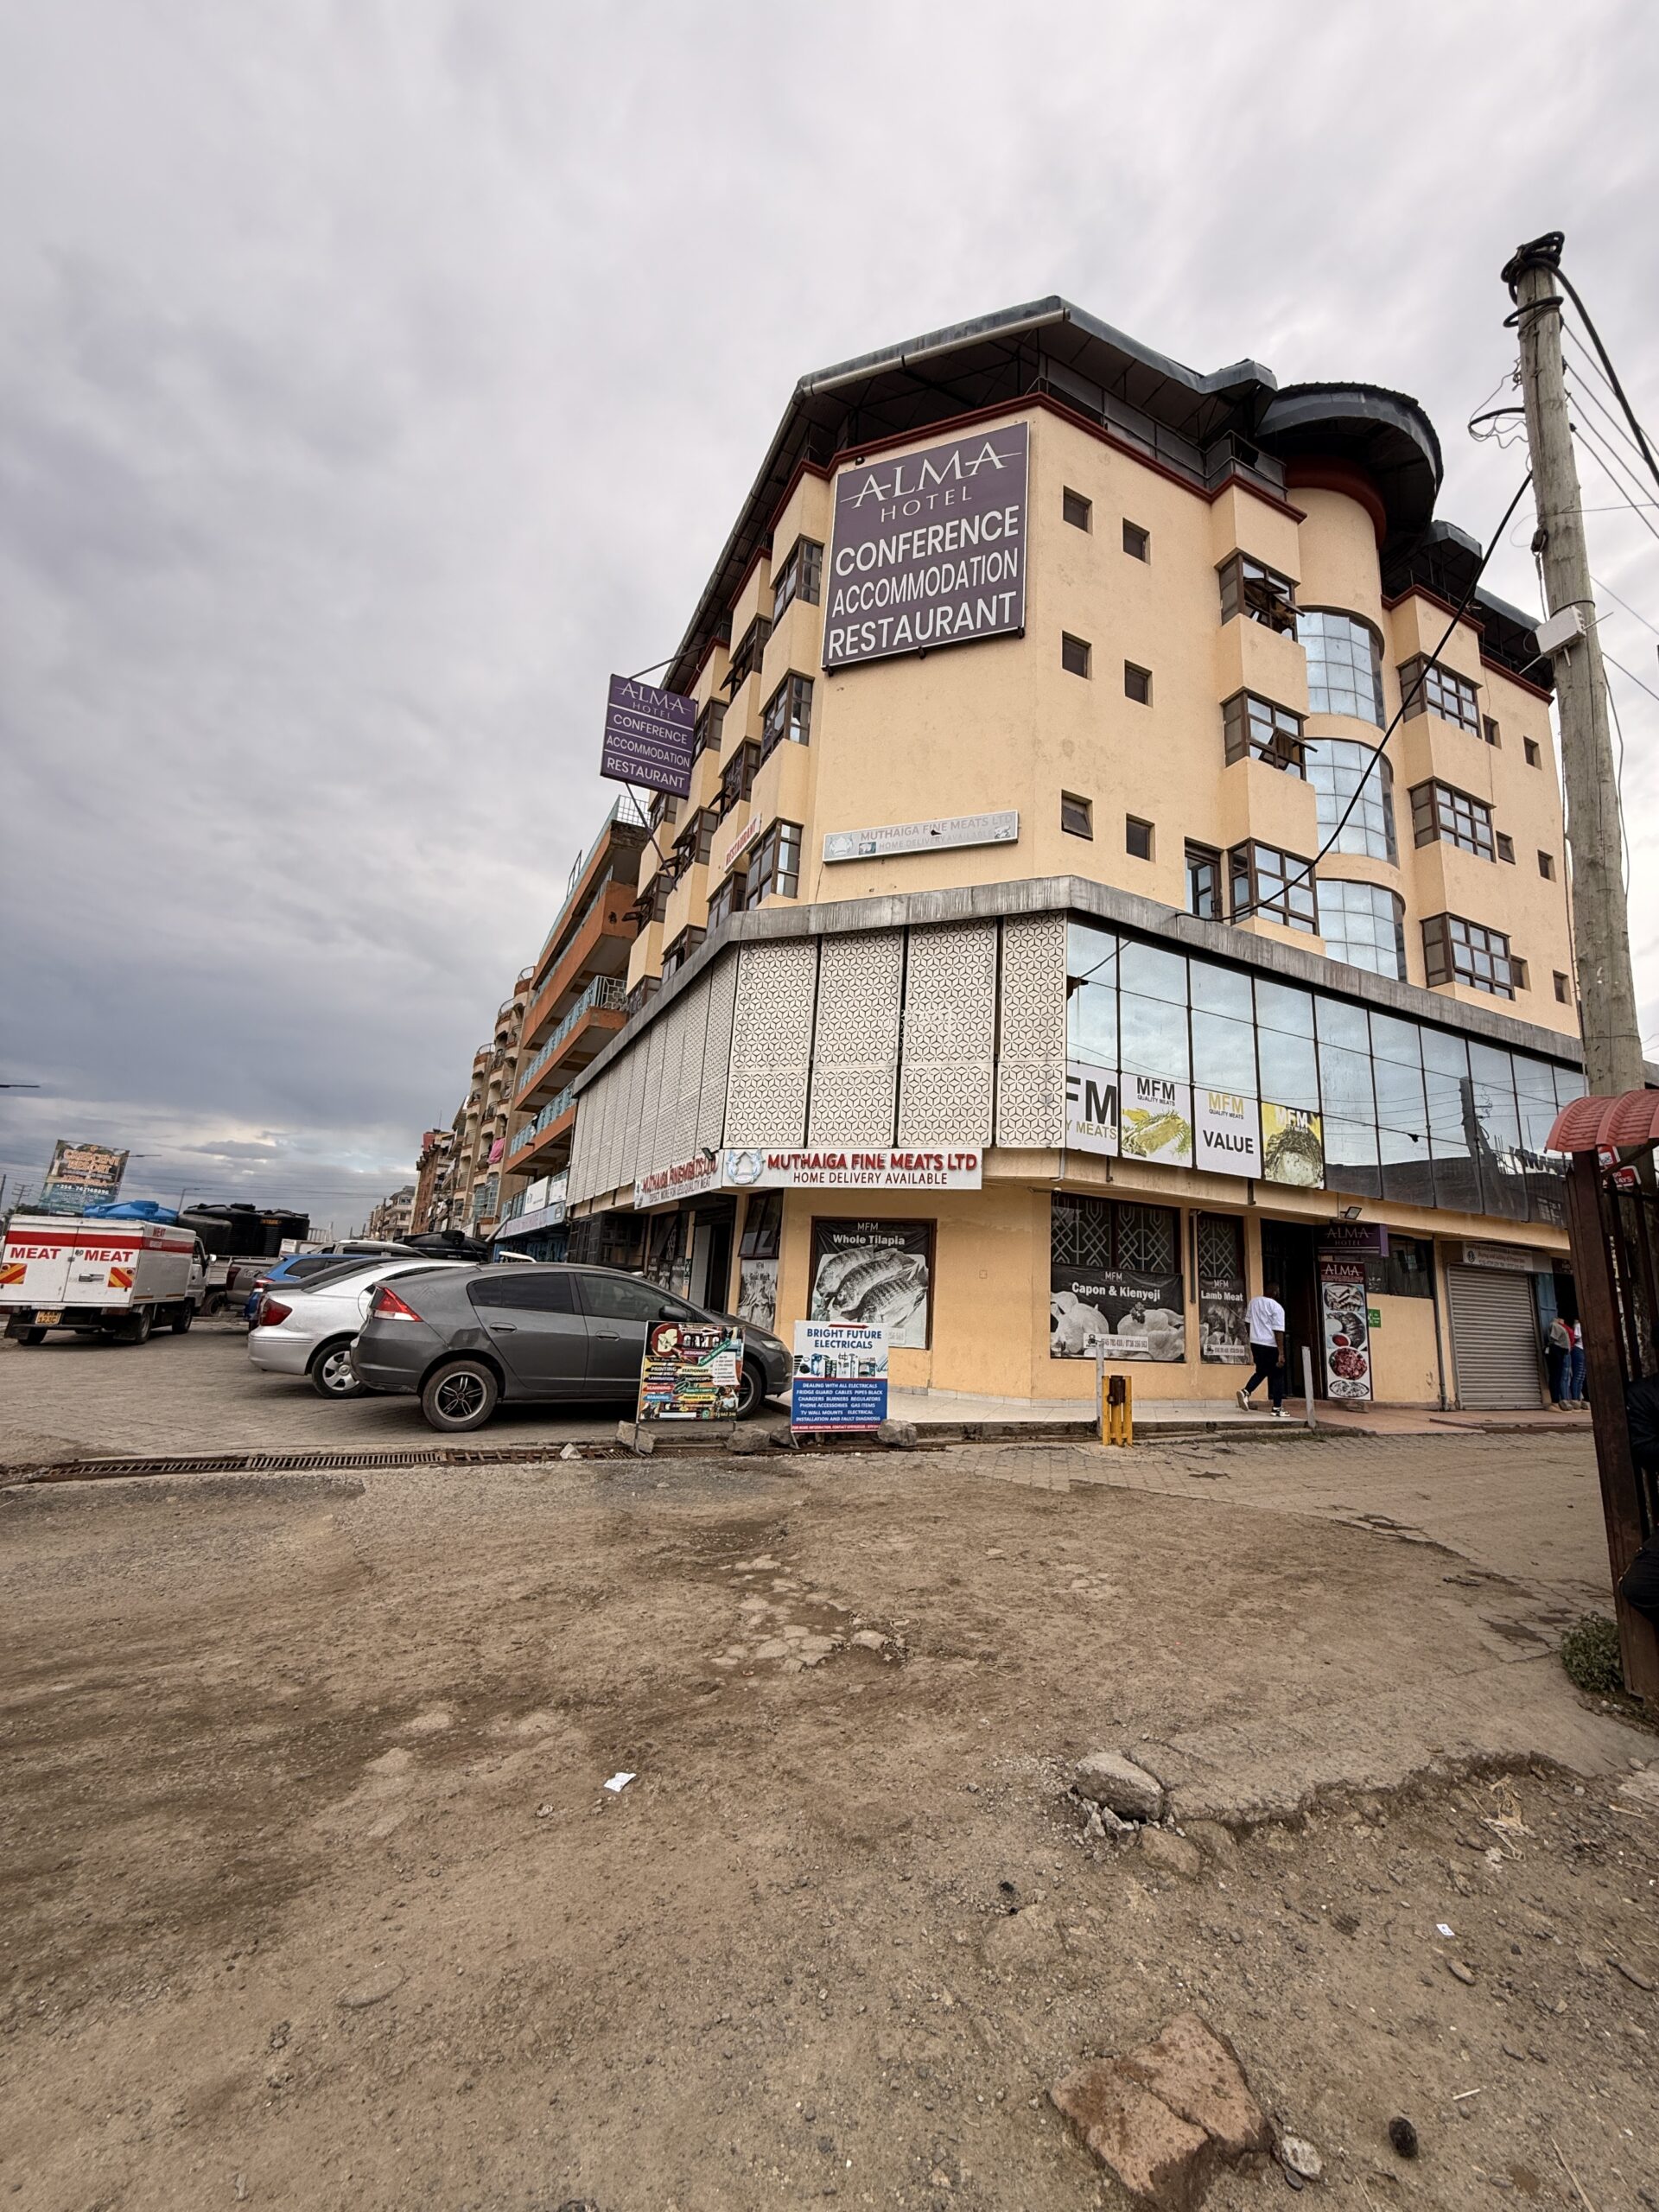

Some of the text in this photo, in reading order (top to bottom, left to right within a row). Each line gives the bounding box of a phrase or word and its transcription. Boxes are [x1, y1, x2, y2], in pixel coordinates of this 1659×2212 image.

[840, 442, 1023, 510] ALMA
[880, 486, 972, 523] HOTEL
[835, 505, 1020, 576] CONFERENCE
[831, 547, 1019, 618] ACCOMMODATION
[828, 591, 1017, 659] RESTAURANT
[614, 682, 692, 715] ALMA
[632, 702, 672, 720] HOTEL
[613, 714, 688, 744] CONFERENCE
[607, 734, 690, 768] ACCOMMODATION
[607, 757, 685, 789] RESTAURANT
[861, 814, 1014, 842] MUTHAIGA FINE MEATS LTD
[726, 817, 757, 867] RESTAURANT
[879, 840, 904, 851] HOME
[906, 835, 945, 849] DELIVERY
[1137, 1077, 1176, 1102] MFM
[1137, 1095, 1176, 1107] QUALITY MEATS
[1208, 1092, 1244, 1115] MFM
[1209, 1109, 1229, 1117] QUALITY
[1076, 1122, 1117, 1140] MEATS
[1202, 1129, 1254, 1154] VALUE
[767, 1154, 977, 1172] MUTHAIGA FINE MEATS LTD
[793, 1172, 948, 1185] HOME DELIVERY AVAILABLE
[152, 1227, 167, 1237] MEAT
[857, 1222, 879, 1231] MFM
[1323, 1226, 1376, 1239] ALMA
[832, 1234, 906, 1246] Whole Tilapia
[10, 1247, 61, 1260] MEAT
[84, 1249, 134, 1262] MEAT
[1105, 1271, 1123, 1281] MFM
[1321, 1264, 1363, 1276] ALMA
[1071, 1281, 1160, 1302] Capon & Kienyeji
[1213, 1280, 1230, 1288] MFM
[1200, 1290, 1244, 1302] Lamb Meat
[807, 1328, 844, 1338] BRIGHT
[846, 1330, 882, 1339] FUTURE
[814, 1339, 874, 1350] ELECTRICALS
